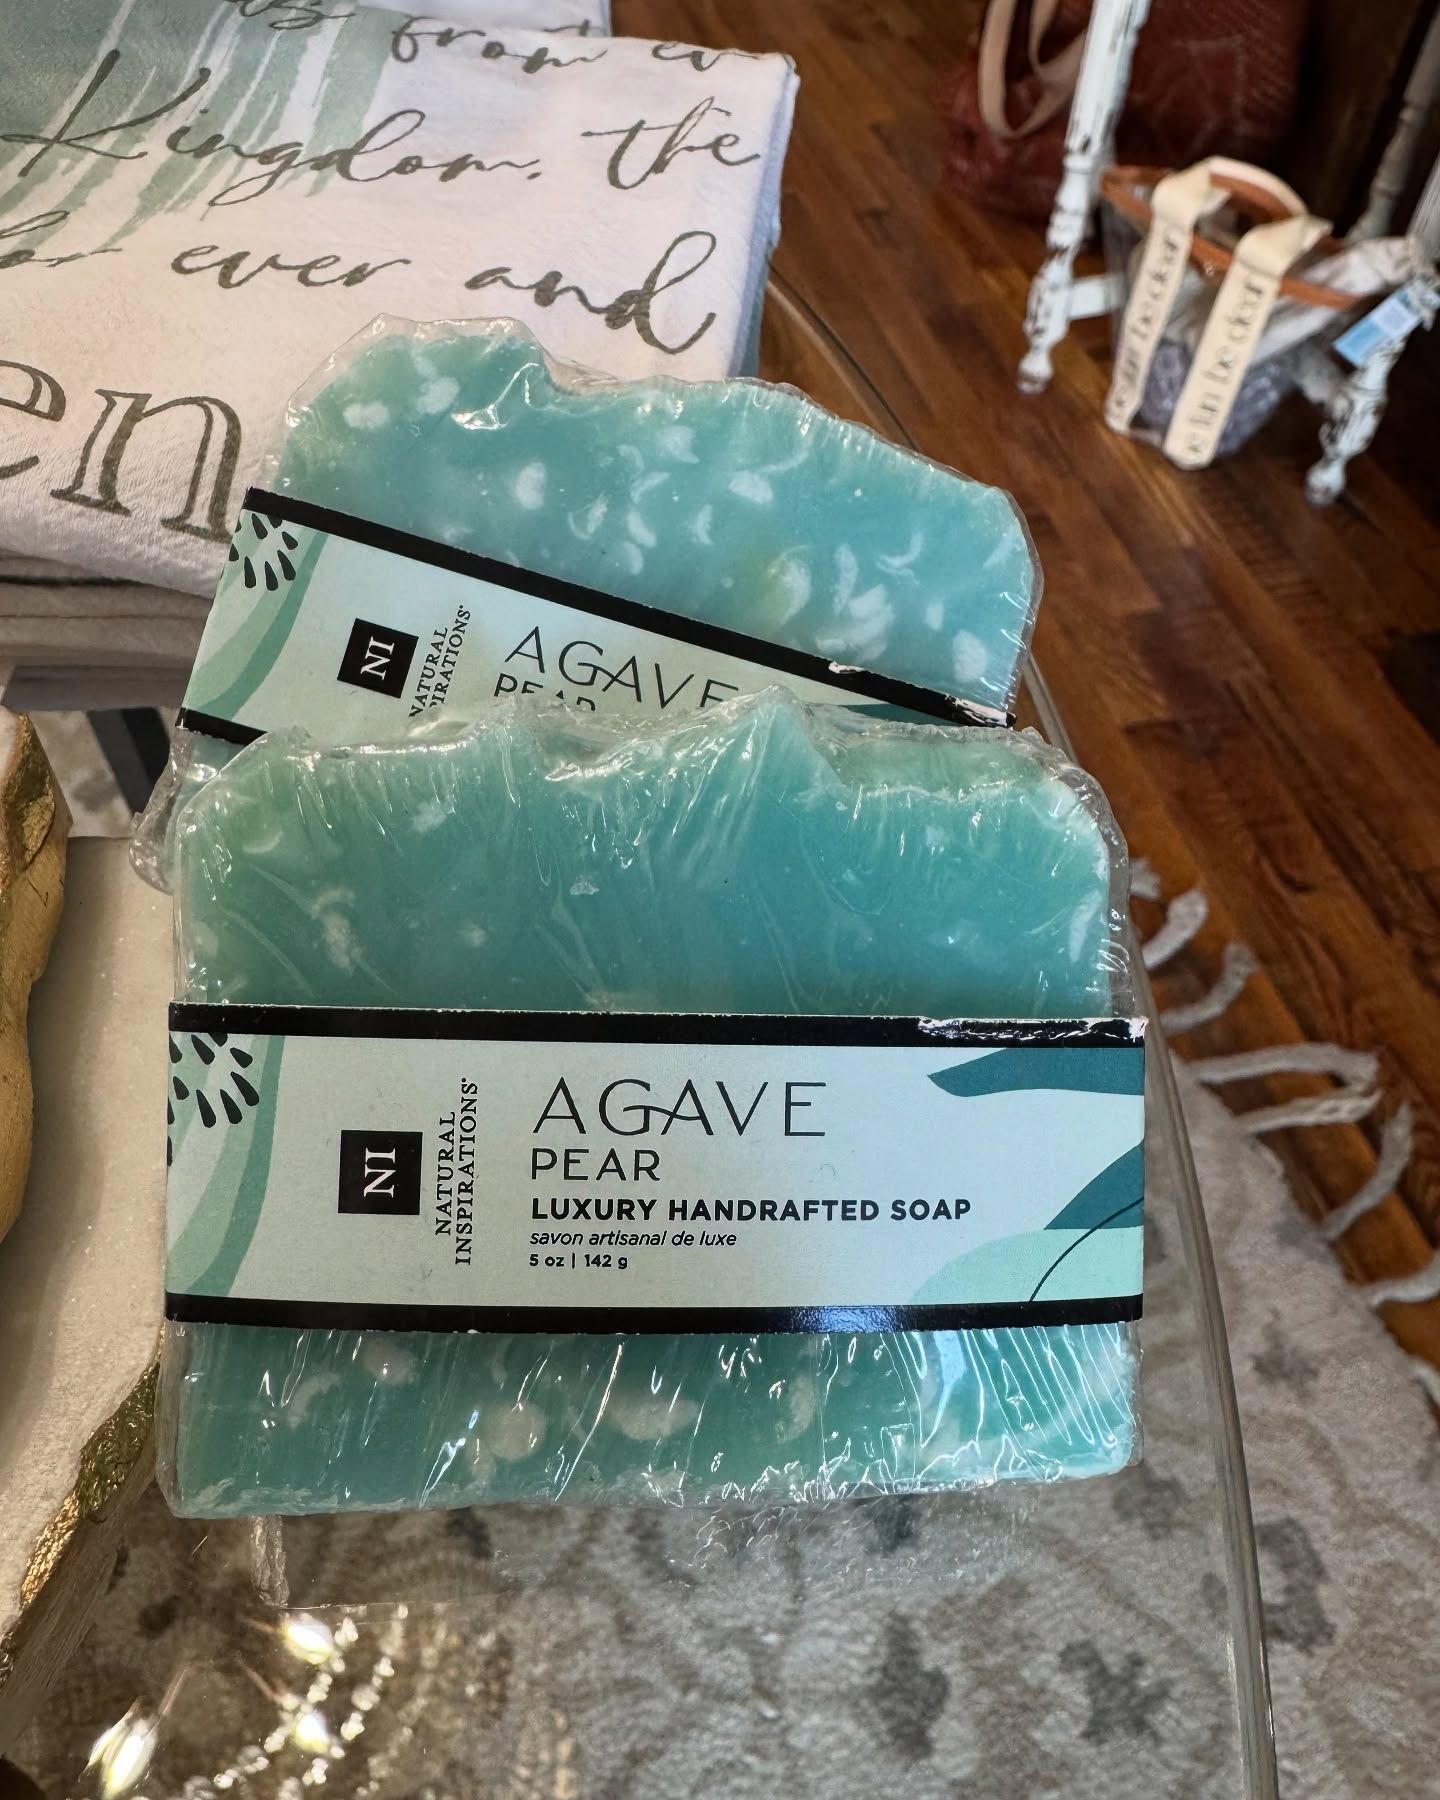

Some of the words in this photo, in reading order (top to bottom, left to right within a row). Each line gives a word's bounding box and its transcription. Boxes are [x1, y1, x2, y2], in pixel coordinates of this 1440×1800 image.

[581, 97, 762, 191] the
[171, 244, 411, 289] ever
[464, 230, 717, 355] and
[360, 636, 395, 680] NI
[504, 626, 739, 709] AGAVE
[533, 1076, 826, 1137] AGAVE
[363, 1147, 396, 1198] NI
[435, 1111, 455, 1236] NATURAL
[531, 1147, 661, 1182] PEAR
[531, 1197, 657, 1221] LUXURY
[668, 1199, 880, 1221] HANDRAFTED
[890, 1198, 971, 1221] SOAP
[529, 1232, 583, 1247] savon
[588, 1230, 666, 1247] artisanal
[671, 1230, 694, 1247] de
[699, 1231, 738, 1247] luxe
[529, 1253, 539, 1268] 5
[544, 1256, 565, 1268] oz
[583, 1254, 612, 1268] 142
[617, 1257, 628, 1270] g
